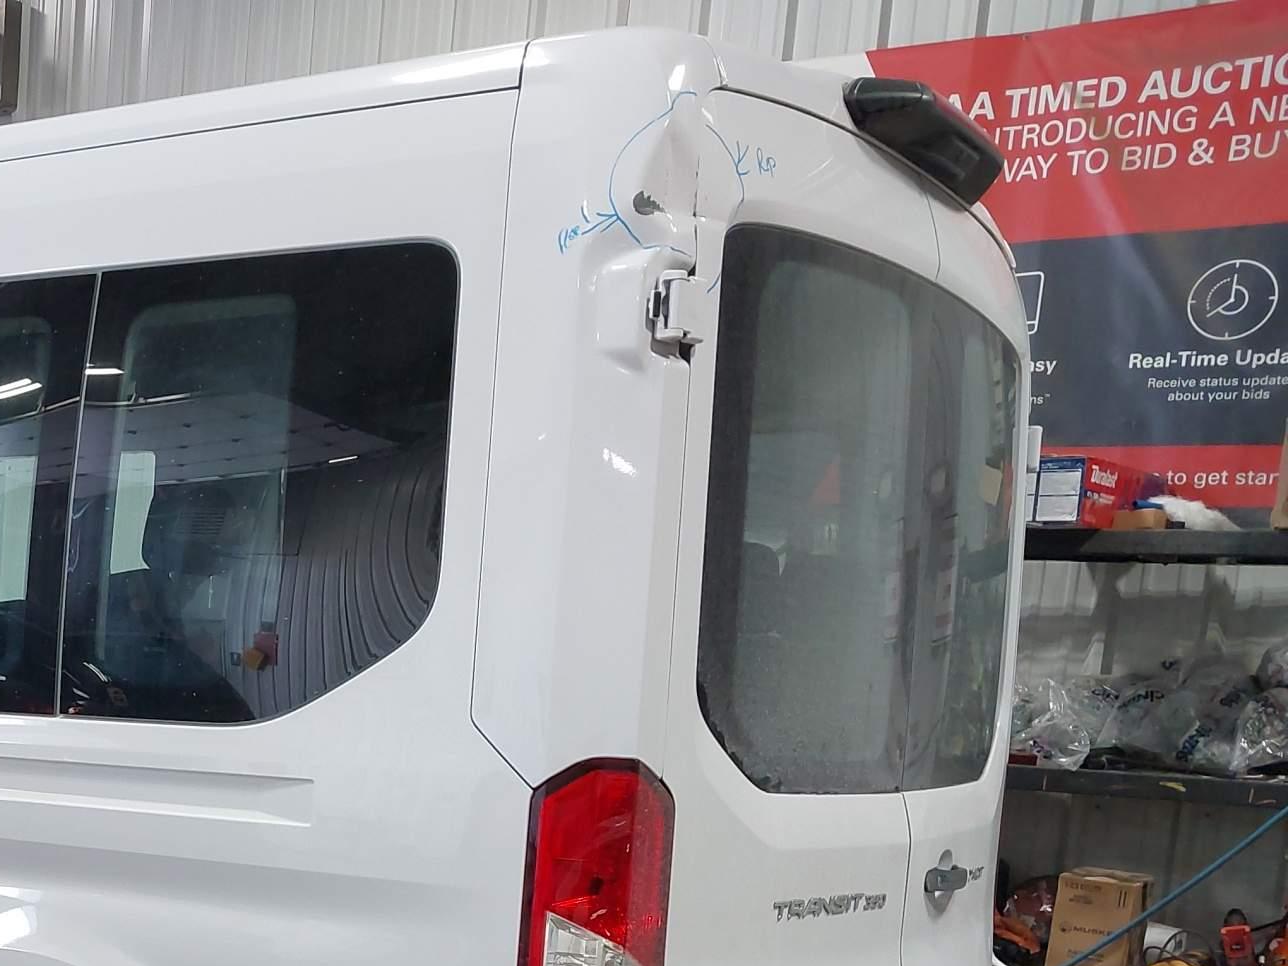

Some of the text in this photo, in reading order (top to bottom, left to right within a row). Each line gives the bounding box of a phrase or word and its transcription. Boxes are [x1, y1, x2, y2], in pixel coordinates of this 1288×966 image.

[1005, 76, 1126, 118] TIMED
[1208, 101, 1236, 129] A
[1067, 148, 1109, 176] TO
[1121, 142, 1177, 172] BID
[1187, 138, 1215, 166] &
[1128, 351, 1229, 369] Real-Time
[1147, 377, 1197, 388] Receive
[1199, 376, 1239, 387] status
[1167, 388, 1271, 403] about your bids
[1166, 470, 1187, 485] to
[1193, 470, 1228, 489] get
[773, 893, 865, 921] TRANSIT
